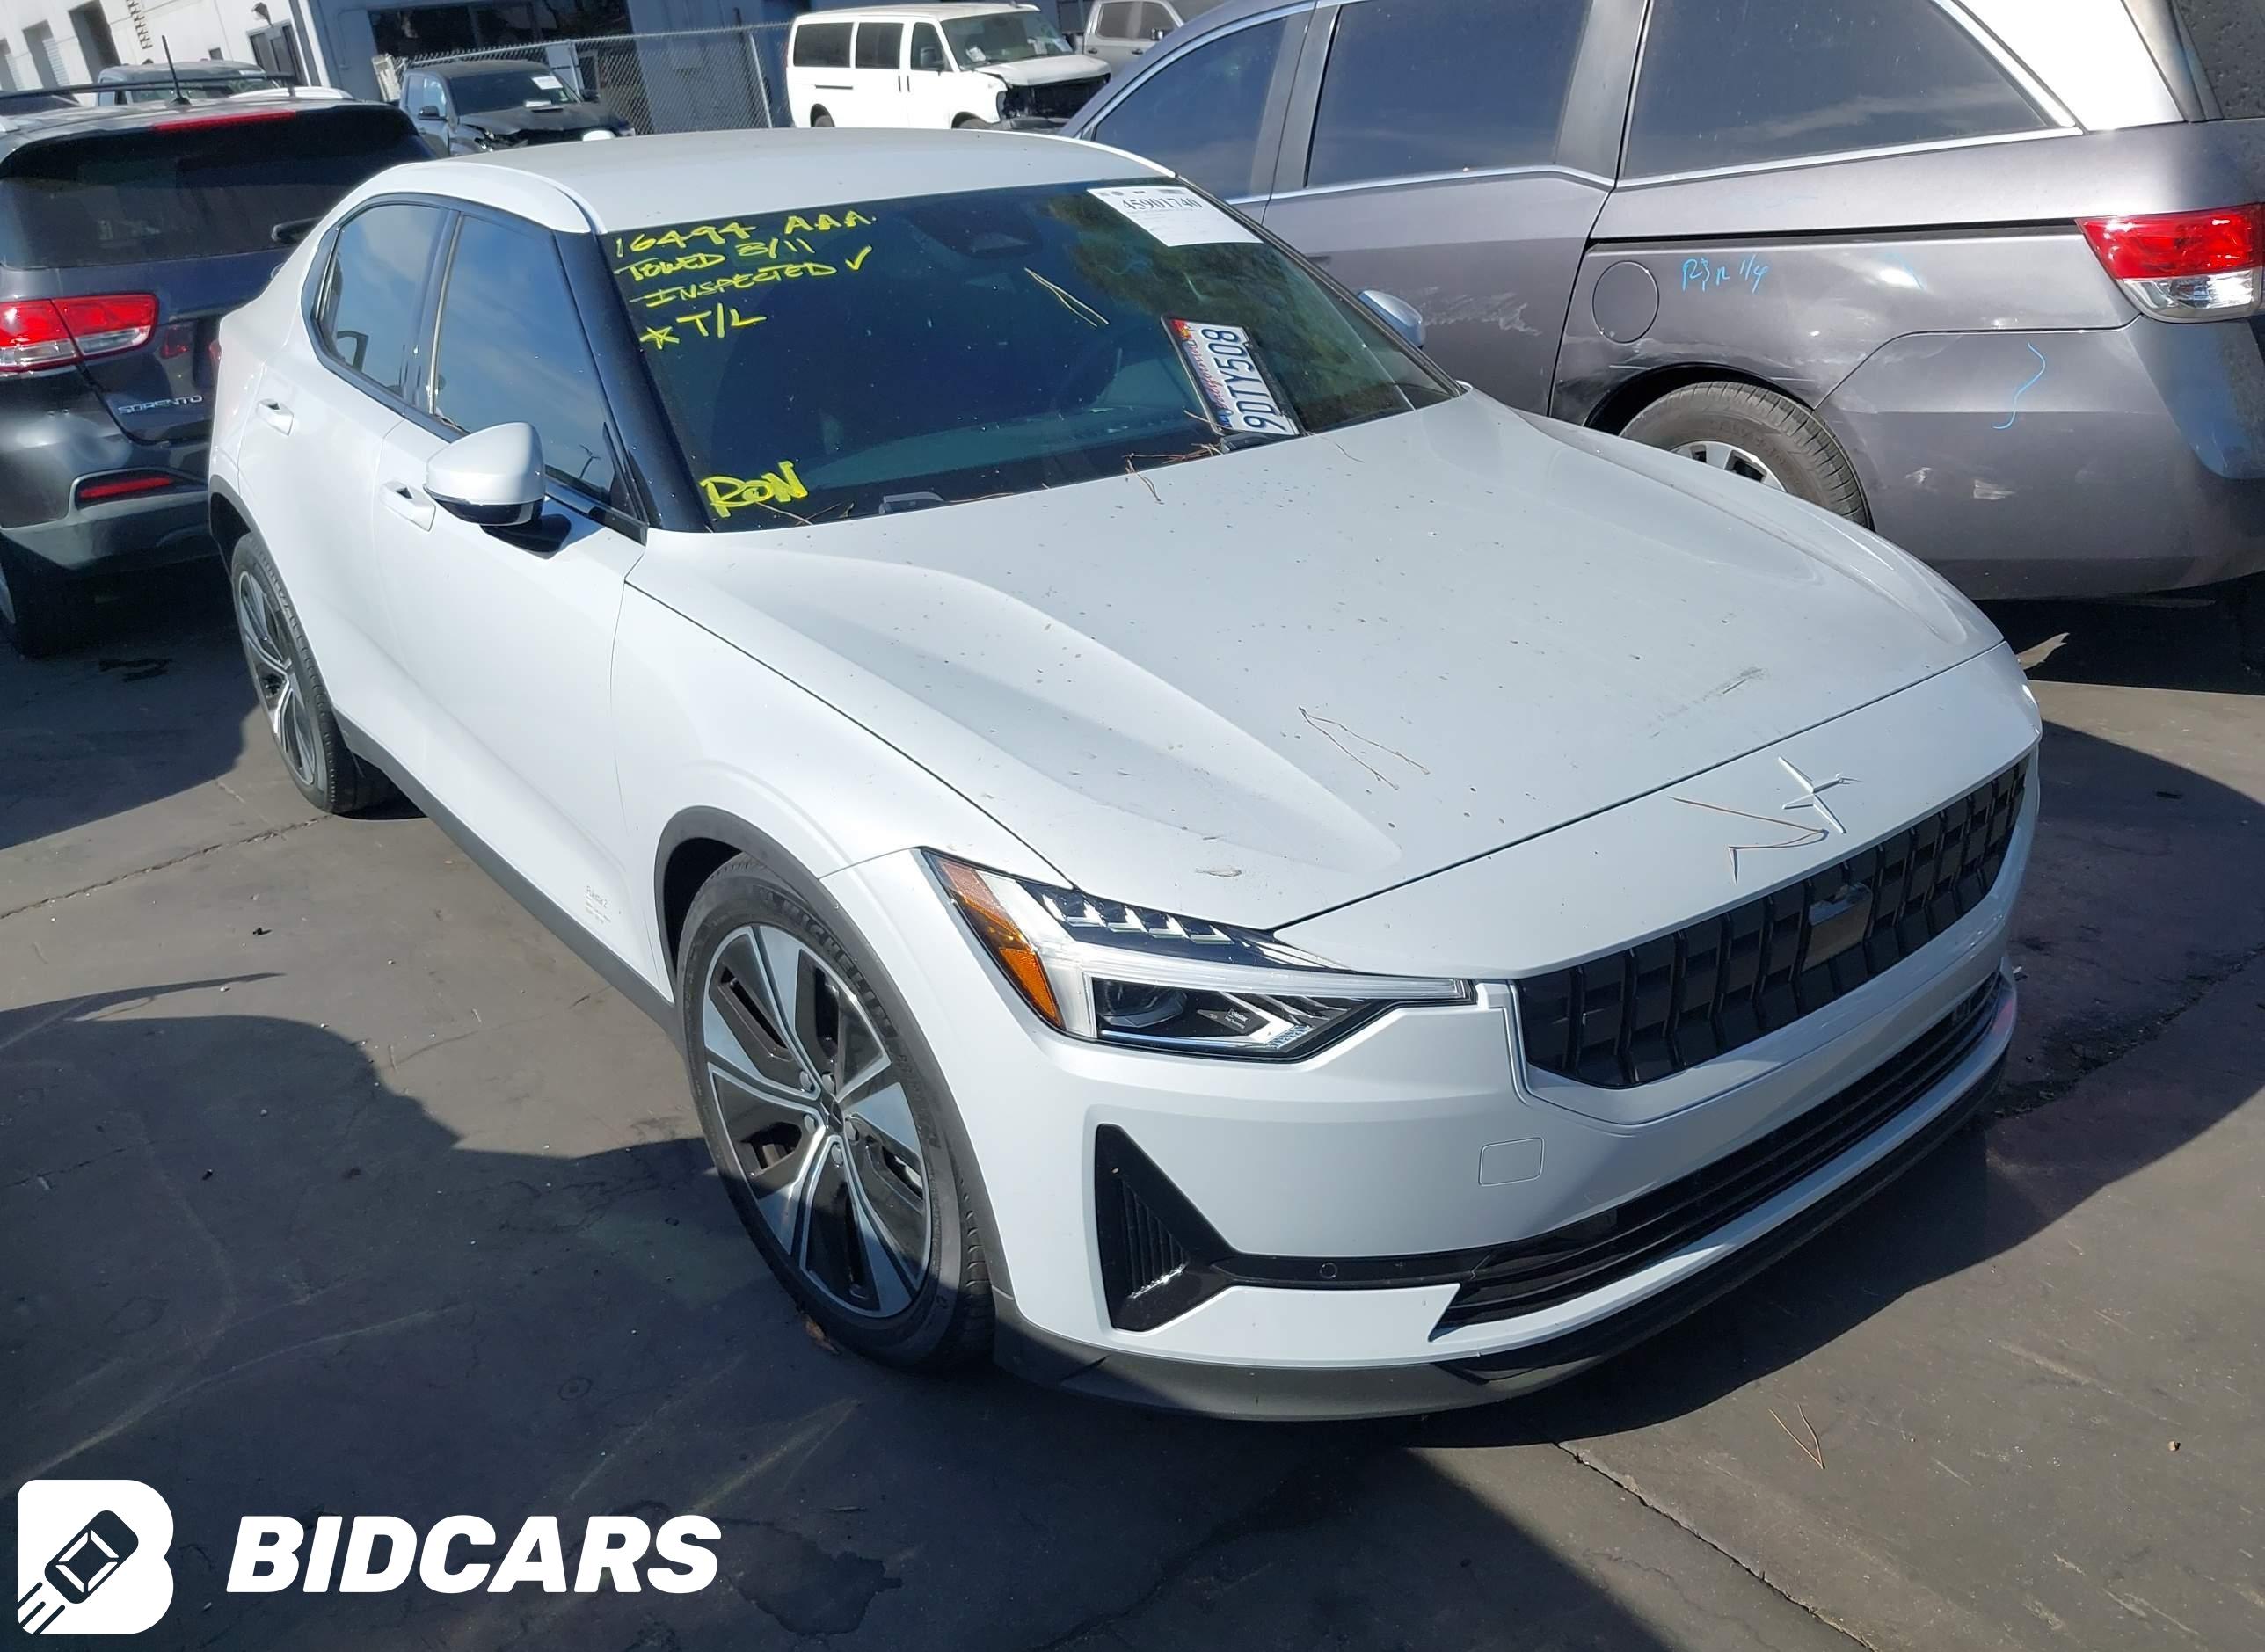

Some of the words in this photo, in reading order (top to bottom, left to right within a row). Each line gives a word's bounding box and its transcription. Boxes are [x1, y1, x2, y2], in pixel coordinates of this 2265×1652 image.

[1122, 197, 1204, 210] 45901740
[613, 253, 726, 281] TOWED
[629, 262, 837, 307] INSPECTED
[675, 302, 768, 338] T/L
[1201, 328, 1287, 431] 9DTY508
[117, 394, 203, 415] SORENTO
[700, 460, 809, 518] RON
